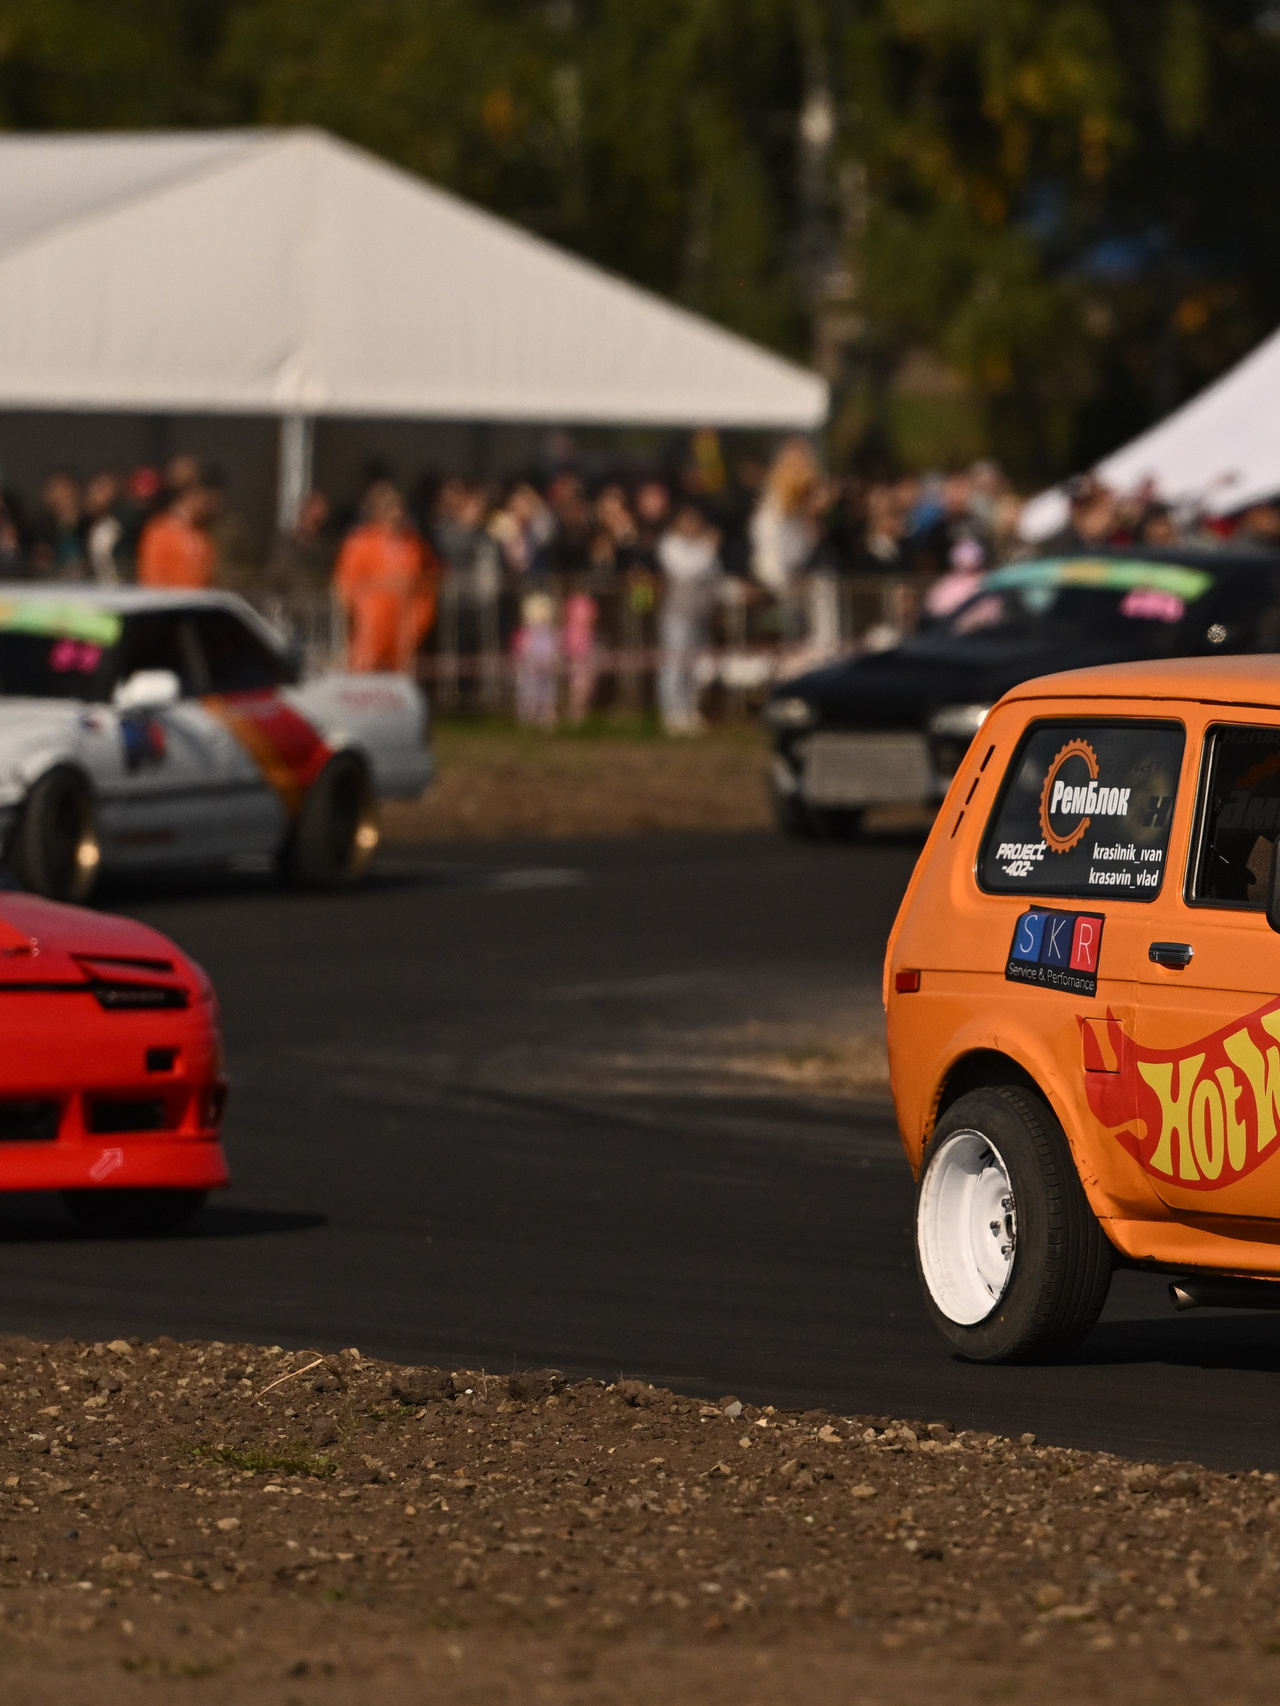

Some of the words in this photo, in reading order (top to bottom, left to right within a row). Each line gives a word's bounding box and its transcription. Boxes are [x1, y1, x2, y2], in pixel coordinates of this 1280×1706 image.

[1050, 780, 1131, 816] РемБлок
[1088, 867, 1160, 889] krasavin_vlad
[1019, 914, 1093, 965] SKR
[1008, 961, 1037, 980] Service
[1038, 968, 1047, 982] &
